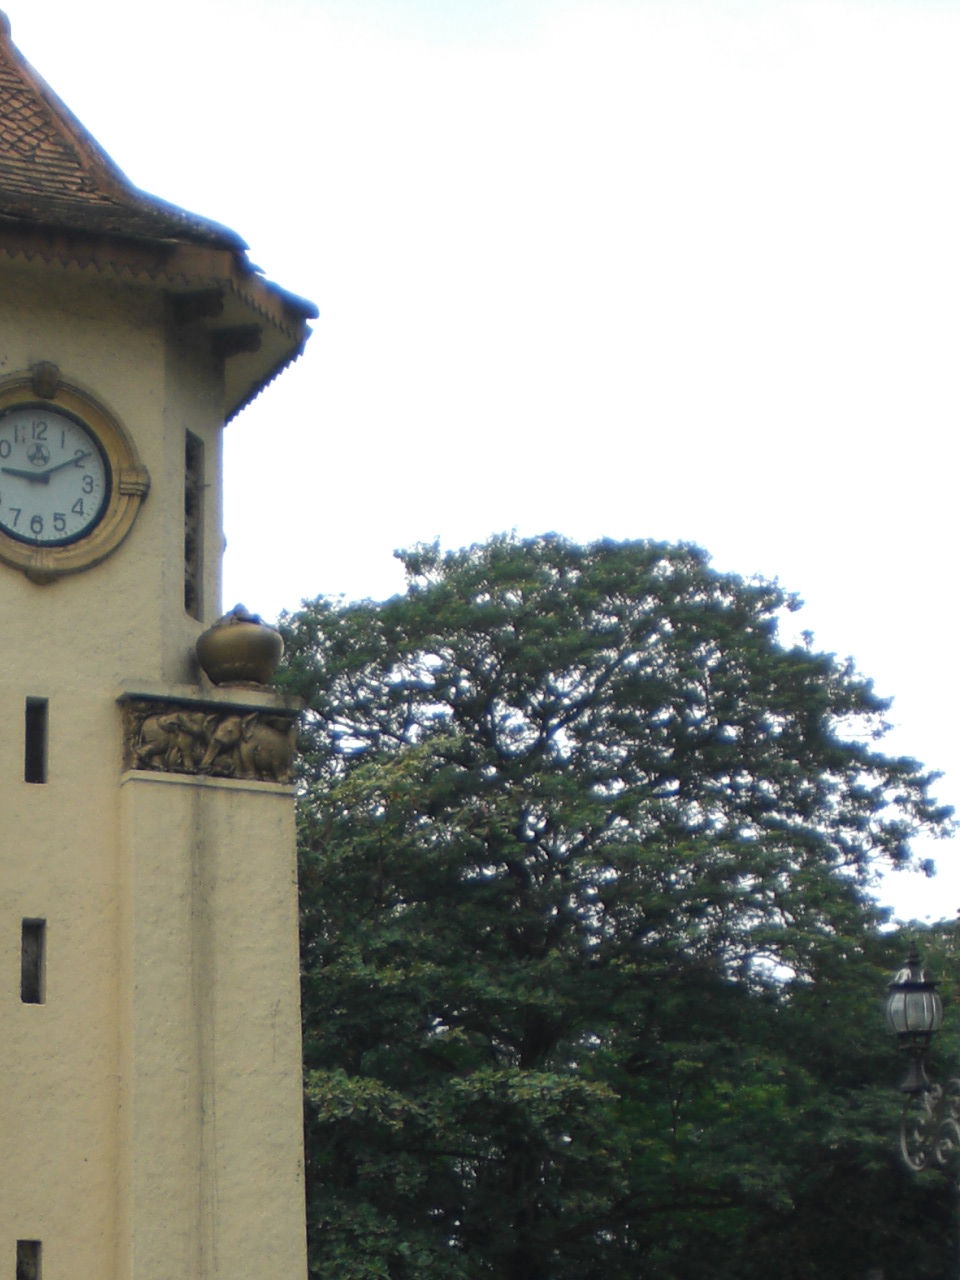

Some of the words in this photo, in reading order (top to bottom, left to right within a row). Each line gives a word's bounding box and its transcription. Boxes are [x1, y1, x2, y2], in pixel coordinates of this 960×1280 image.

[31, 421, 48, 441] 12
[82, 475, 94, 495] 3
[72, 498, 84, 517] 4
[9, 508, 22, 528] 7
[30, 515, 43, 534] 6
[53, 513, 66, 532] 5
